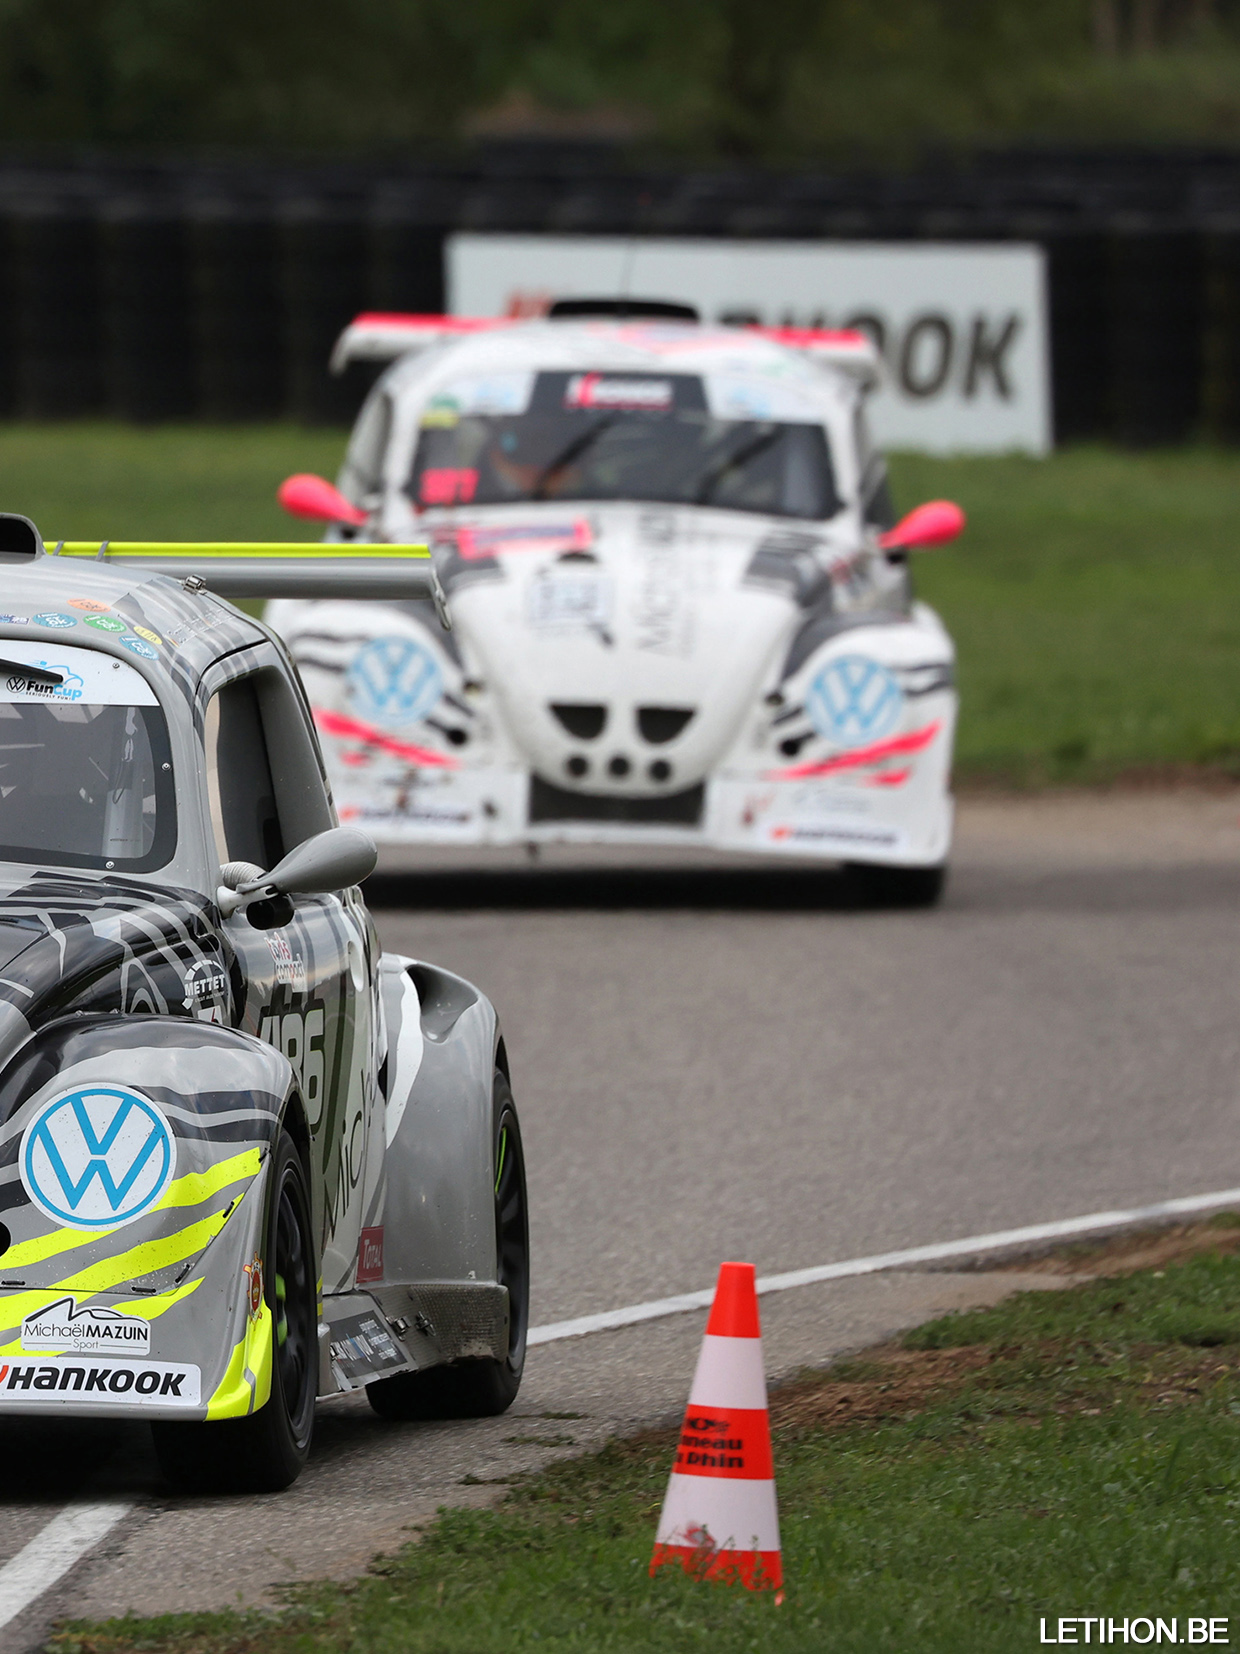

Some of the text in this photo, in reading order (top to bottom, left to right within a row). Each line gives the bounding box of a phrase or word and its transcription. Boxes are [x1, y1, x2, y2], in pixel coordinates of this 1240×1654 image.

[26, 680, 83, 701] FunCup
[184, 974, 226, 997] METTET
[72, 1338, 100, 1352] Sport
